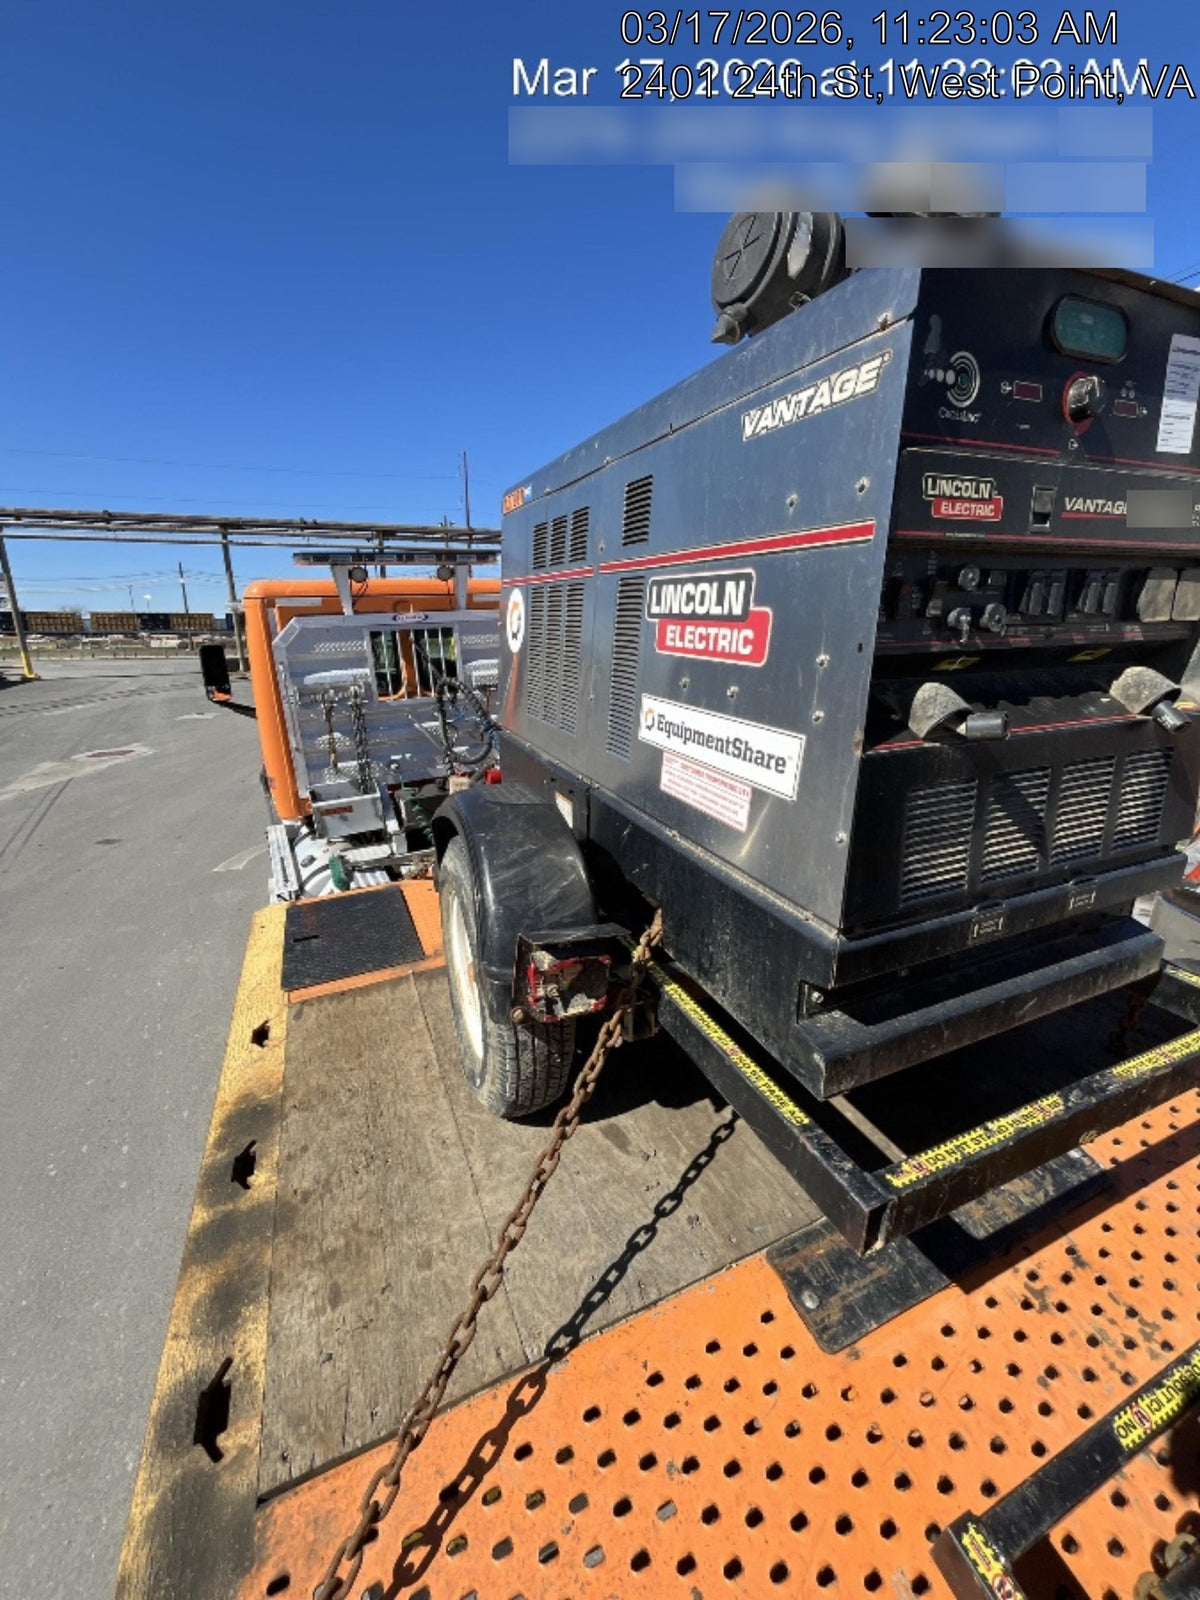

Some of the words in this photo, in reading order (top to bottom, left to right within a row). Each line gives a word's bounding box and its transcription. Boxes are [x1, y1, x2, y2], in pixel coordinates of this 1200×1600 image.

[926, 476, 992, 500] LINCOLN
[939, 500, 996, 517] ELECTRIC
[649, 579, 747, 617] LINCOLN
[664, 623, 756, 656] ELECTRIC
[656, 712, 788, 776] EquipmentShare
[924, 1153, 947, 1166] DO
[1146, 1398, 1166, 1416] ICI
[1116, 1418, 1138, 1439] NO
